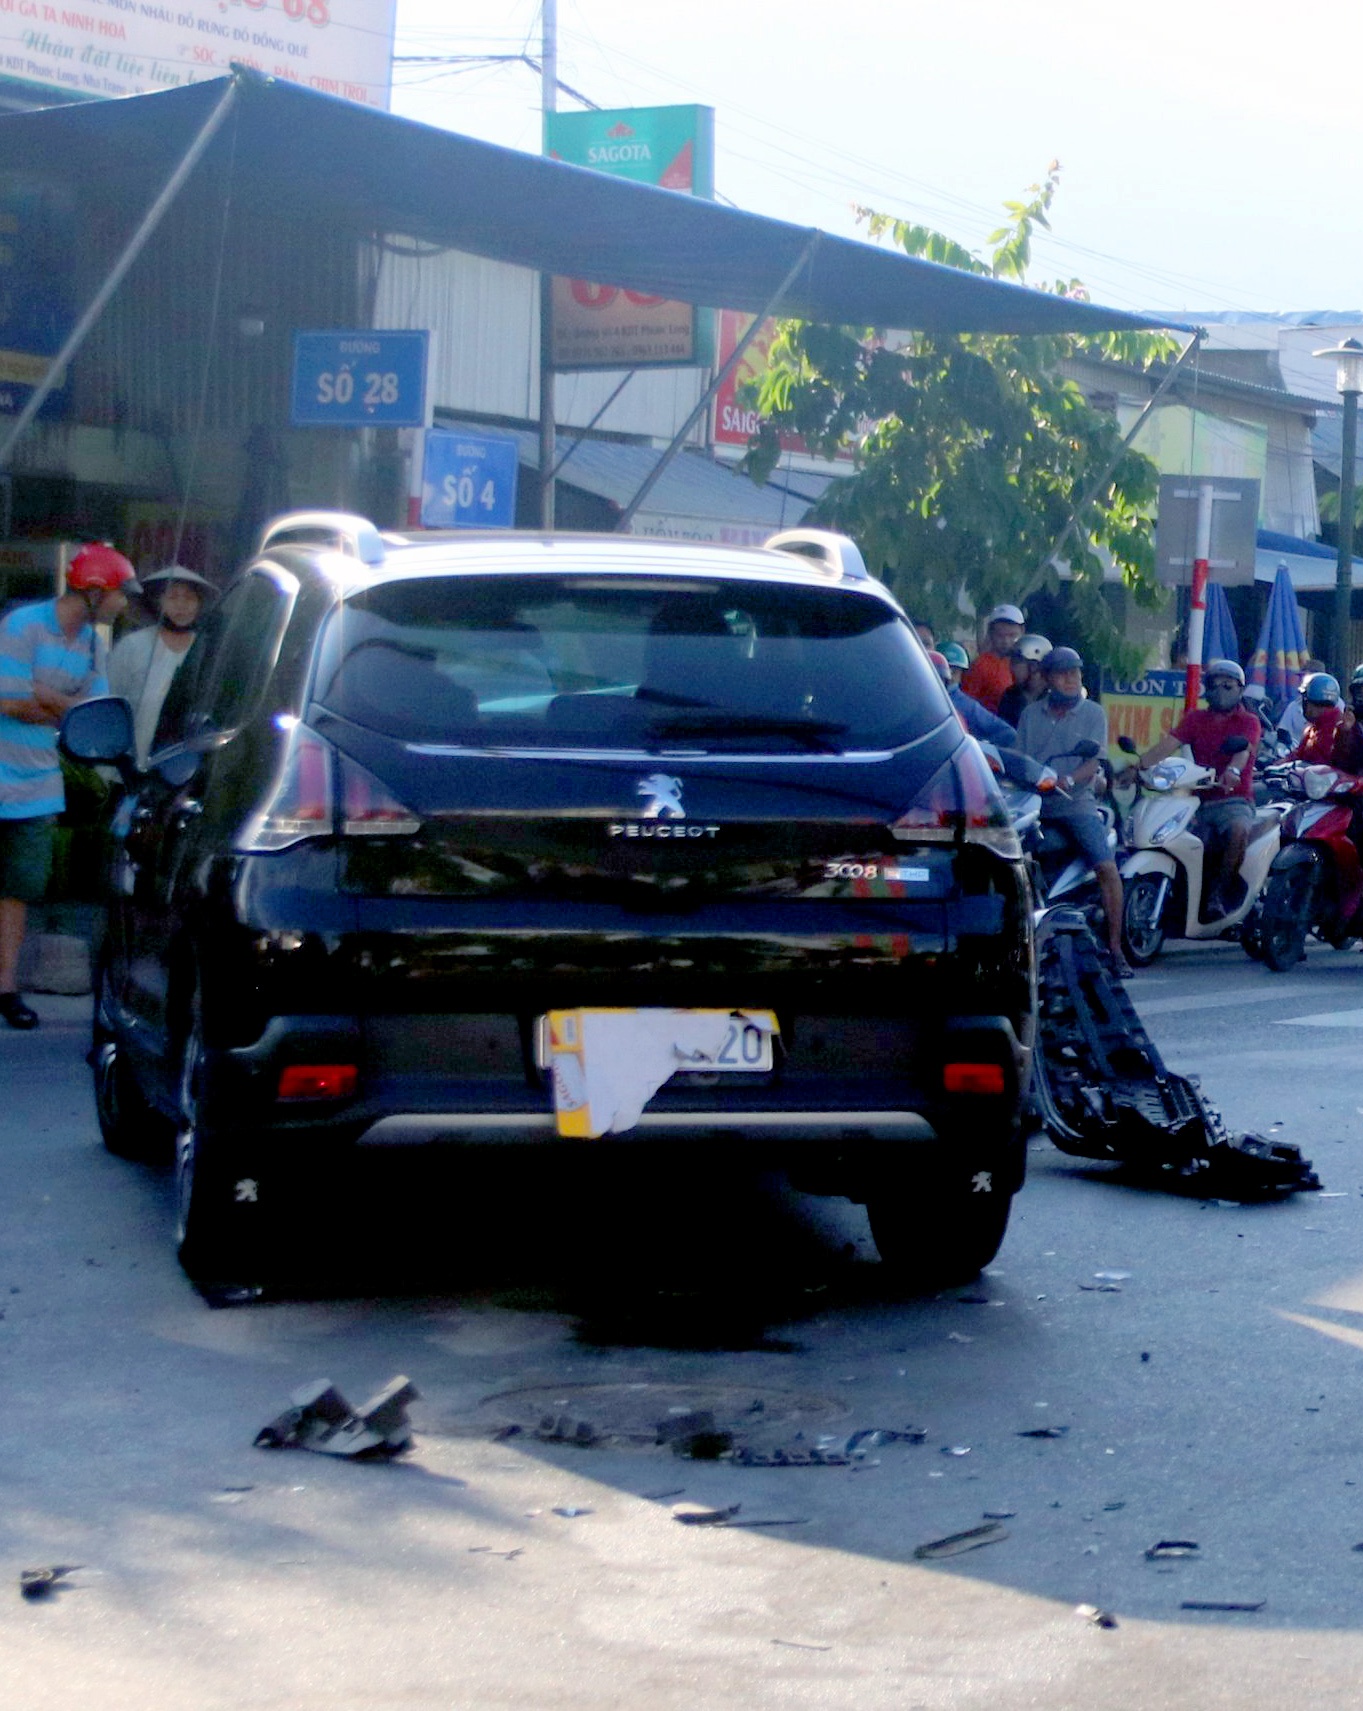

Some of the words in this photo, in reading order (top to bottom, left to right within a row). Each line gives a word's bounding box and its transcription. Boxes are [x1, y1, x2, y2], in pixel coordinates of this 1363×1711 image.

[587, 143, 652, 164] SAGOTA
[317, 360, 356, 404] SỐ
[363, 371, 399, 404] 28
[443, 464, 478, 508] SỐ
[480, 479, 496, 511] 4
[608, 824, 720, 838] PEUGEOT
[824, 862, 878, 880] 3008
